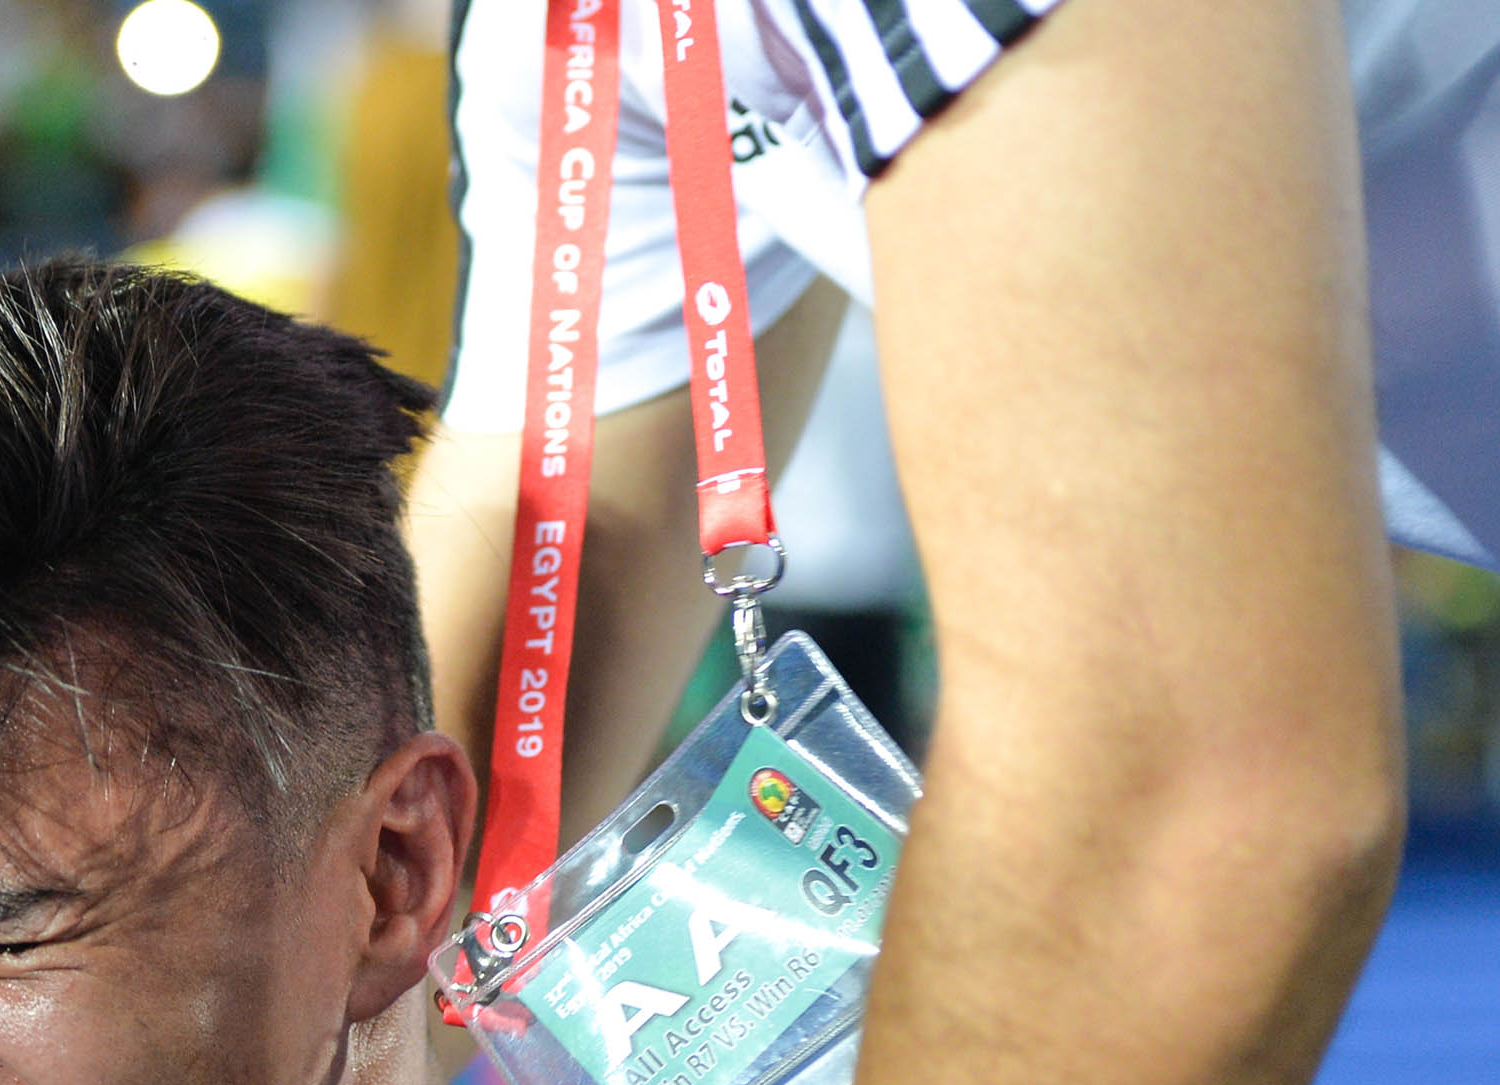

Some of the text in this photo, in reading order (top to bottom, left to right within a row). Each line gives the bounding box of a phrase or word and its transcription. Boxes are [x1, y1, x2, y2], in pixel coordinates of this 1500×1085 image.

[564, 0, 601, 134] AFRICA
[541, 309, 581, 478] NATIONS
[704, 330, 733, 452] TOTAL
[525, 520, 566, 656] EGYPT
[516, 668, 549, 758] 2019
[609, 906, 654, 948] Africa
[802, 826, 879, 916] QF3
[665, 970, 751, 1056] Access
[686, 1042, 716, 1077] R7
[746, 976, 794, 1018] Win
[786, 947, 821, 981] R6
